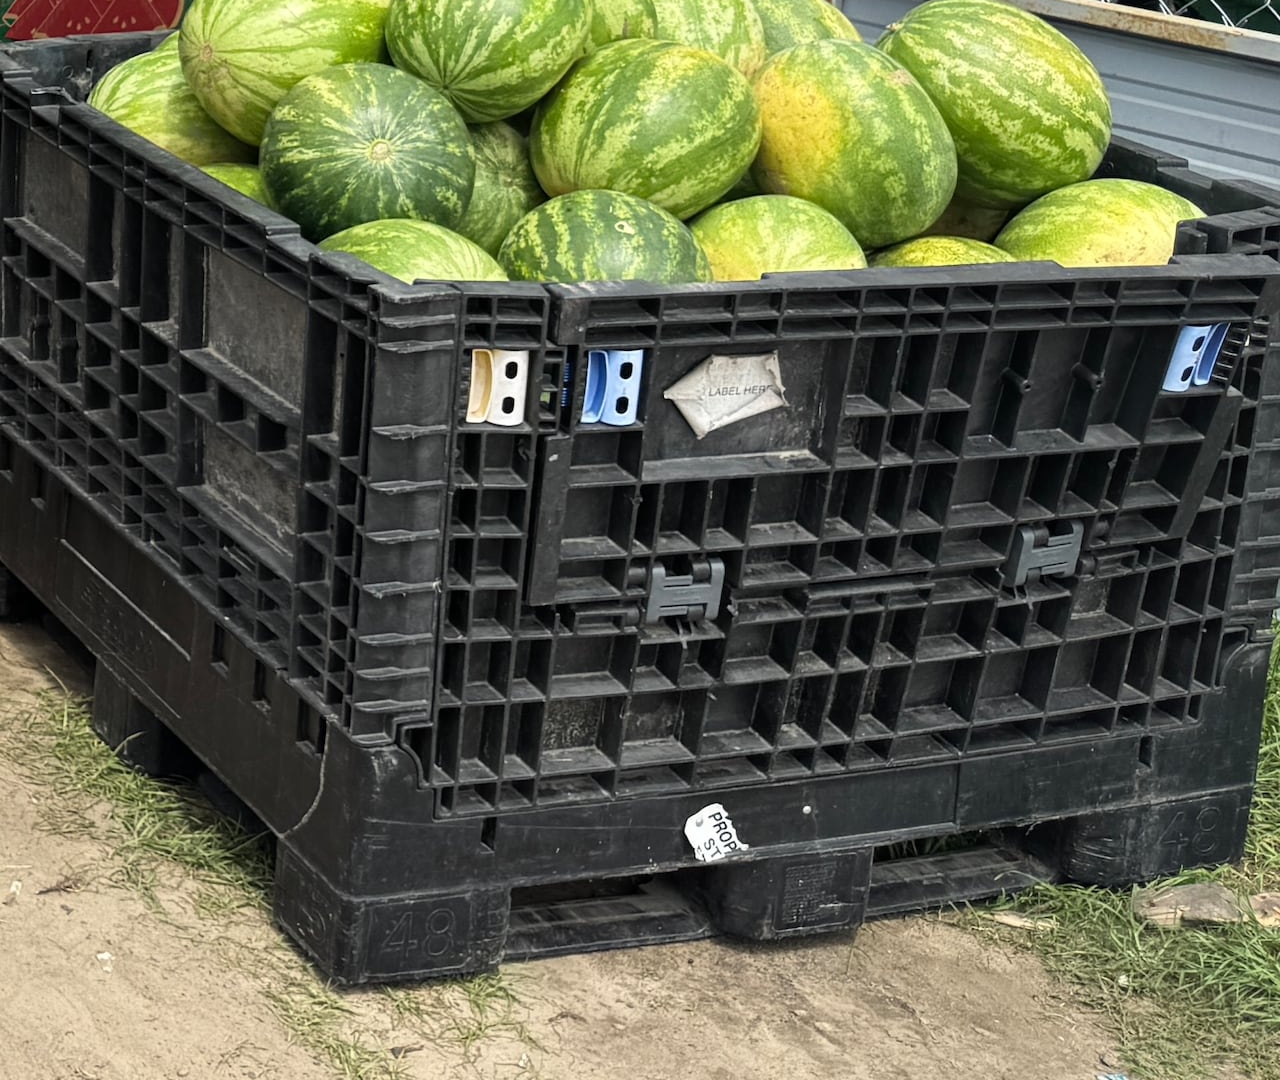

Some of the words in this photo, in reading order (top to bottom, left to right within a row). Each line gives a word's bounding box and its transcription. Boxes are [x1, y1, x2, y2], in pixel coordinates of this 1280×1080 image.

[709, 386, 741, 397] LABEL
[1159, 806, 1222, 858] 48
[381, 908, 456, 960] 48
